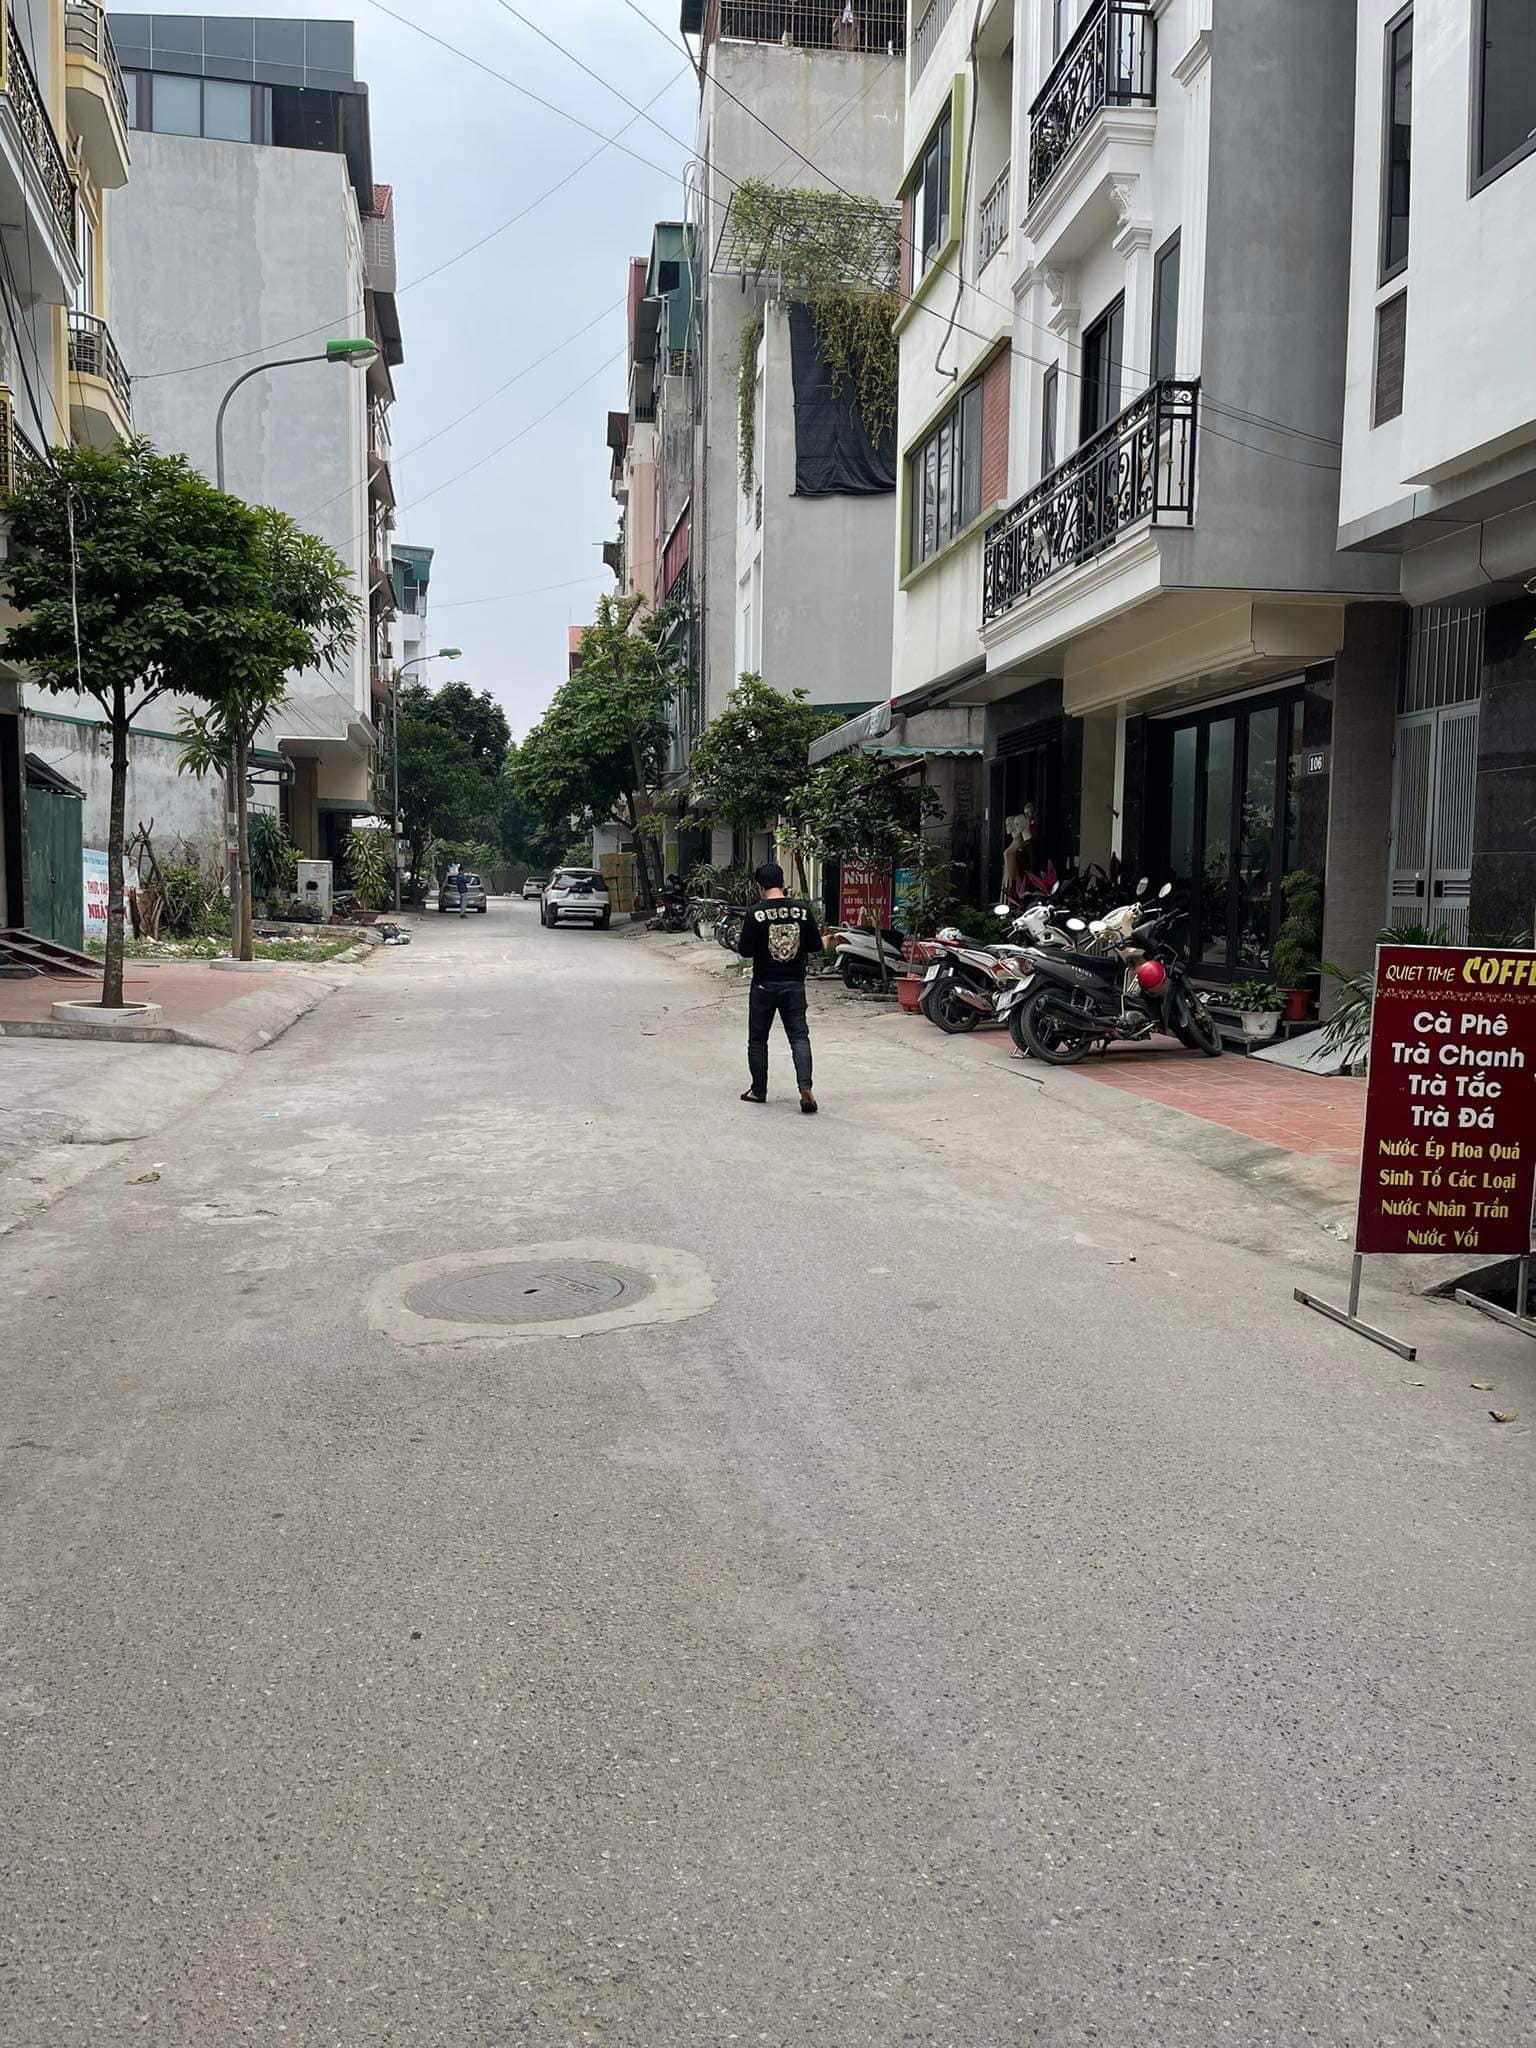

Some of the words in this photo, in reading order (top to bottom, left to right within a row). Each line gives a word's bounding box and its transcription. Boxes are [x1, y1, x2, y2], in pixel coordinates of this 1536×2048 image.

[1310, 756, 1323, 771] 106
[754, 907, 807, 922] GUCCI
[1385, 964, 1424, 982] QUIET
[1427, 966, 1456, 983] TIME
[1413, 1010, 1452, 1034] Cà
[1460, 1013, 1509, 1036] Phê
[1392, 1041, 1431, 1065] Trà
[1439, 1044, 1525, 1068] Chanh
[1408, 1073, 1447, 1096] Trà
[1456, 1071, 1502, 1098] Tắc
[1411, 1104, 1449, 1127] Trà
[1458, 1105, 1495, 1129] Đá
[1379, 1138, 1419, 1157] Nước
[1425, 1136, 1445, 1160] Ép
[1451, 1142, 1483, 1159] Hoa
[1379, 1169, 1413, 1186] Sinh
[1421, 1167, 1442, 1187] Tố
[1448, 1169, 1476, 1188] Các
[1483, 1173, 1516, 1193] Loại
[1381, 1198, 1421, 1216] Nước
[1427, 1199, 1466, 1217] Nhân
[1473, 1198, 1509, 1218] Trần
[1407, 1228, 1447, 1246] Nước
[1454, 1227, 1479, 1247] Vối
